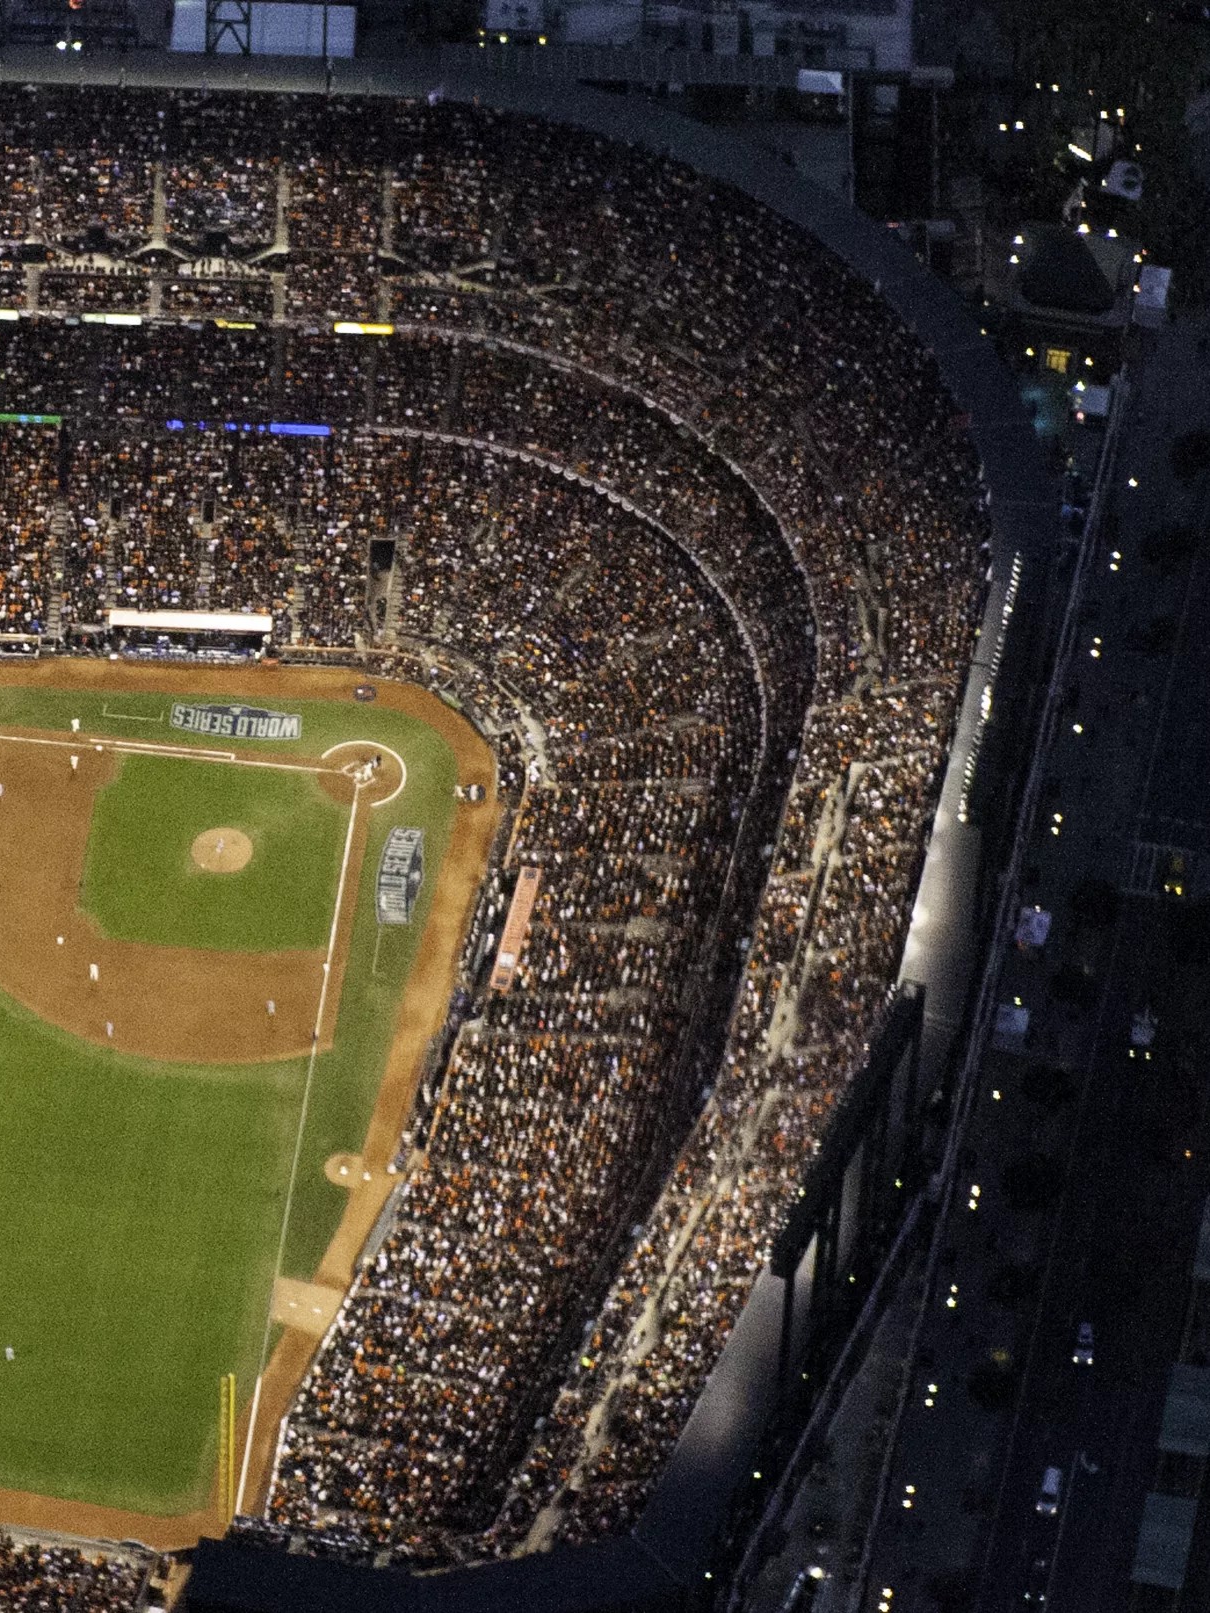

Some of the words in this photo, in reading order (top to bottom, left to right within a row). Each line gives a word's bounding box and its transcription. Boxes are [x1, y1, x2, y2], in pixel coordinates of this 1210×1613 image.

[173, 704, 234, 735] SERIES
[236, 716, 298, 738] WORLD
[382, 829, 421, 875] SERIES
[379, 874, 407, 921] WORLD
